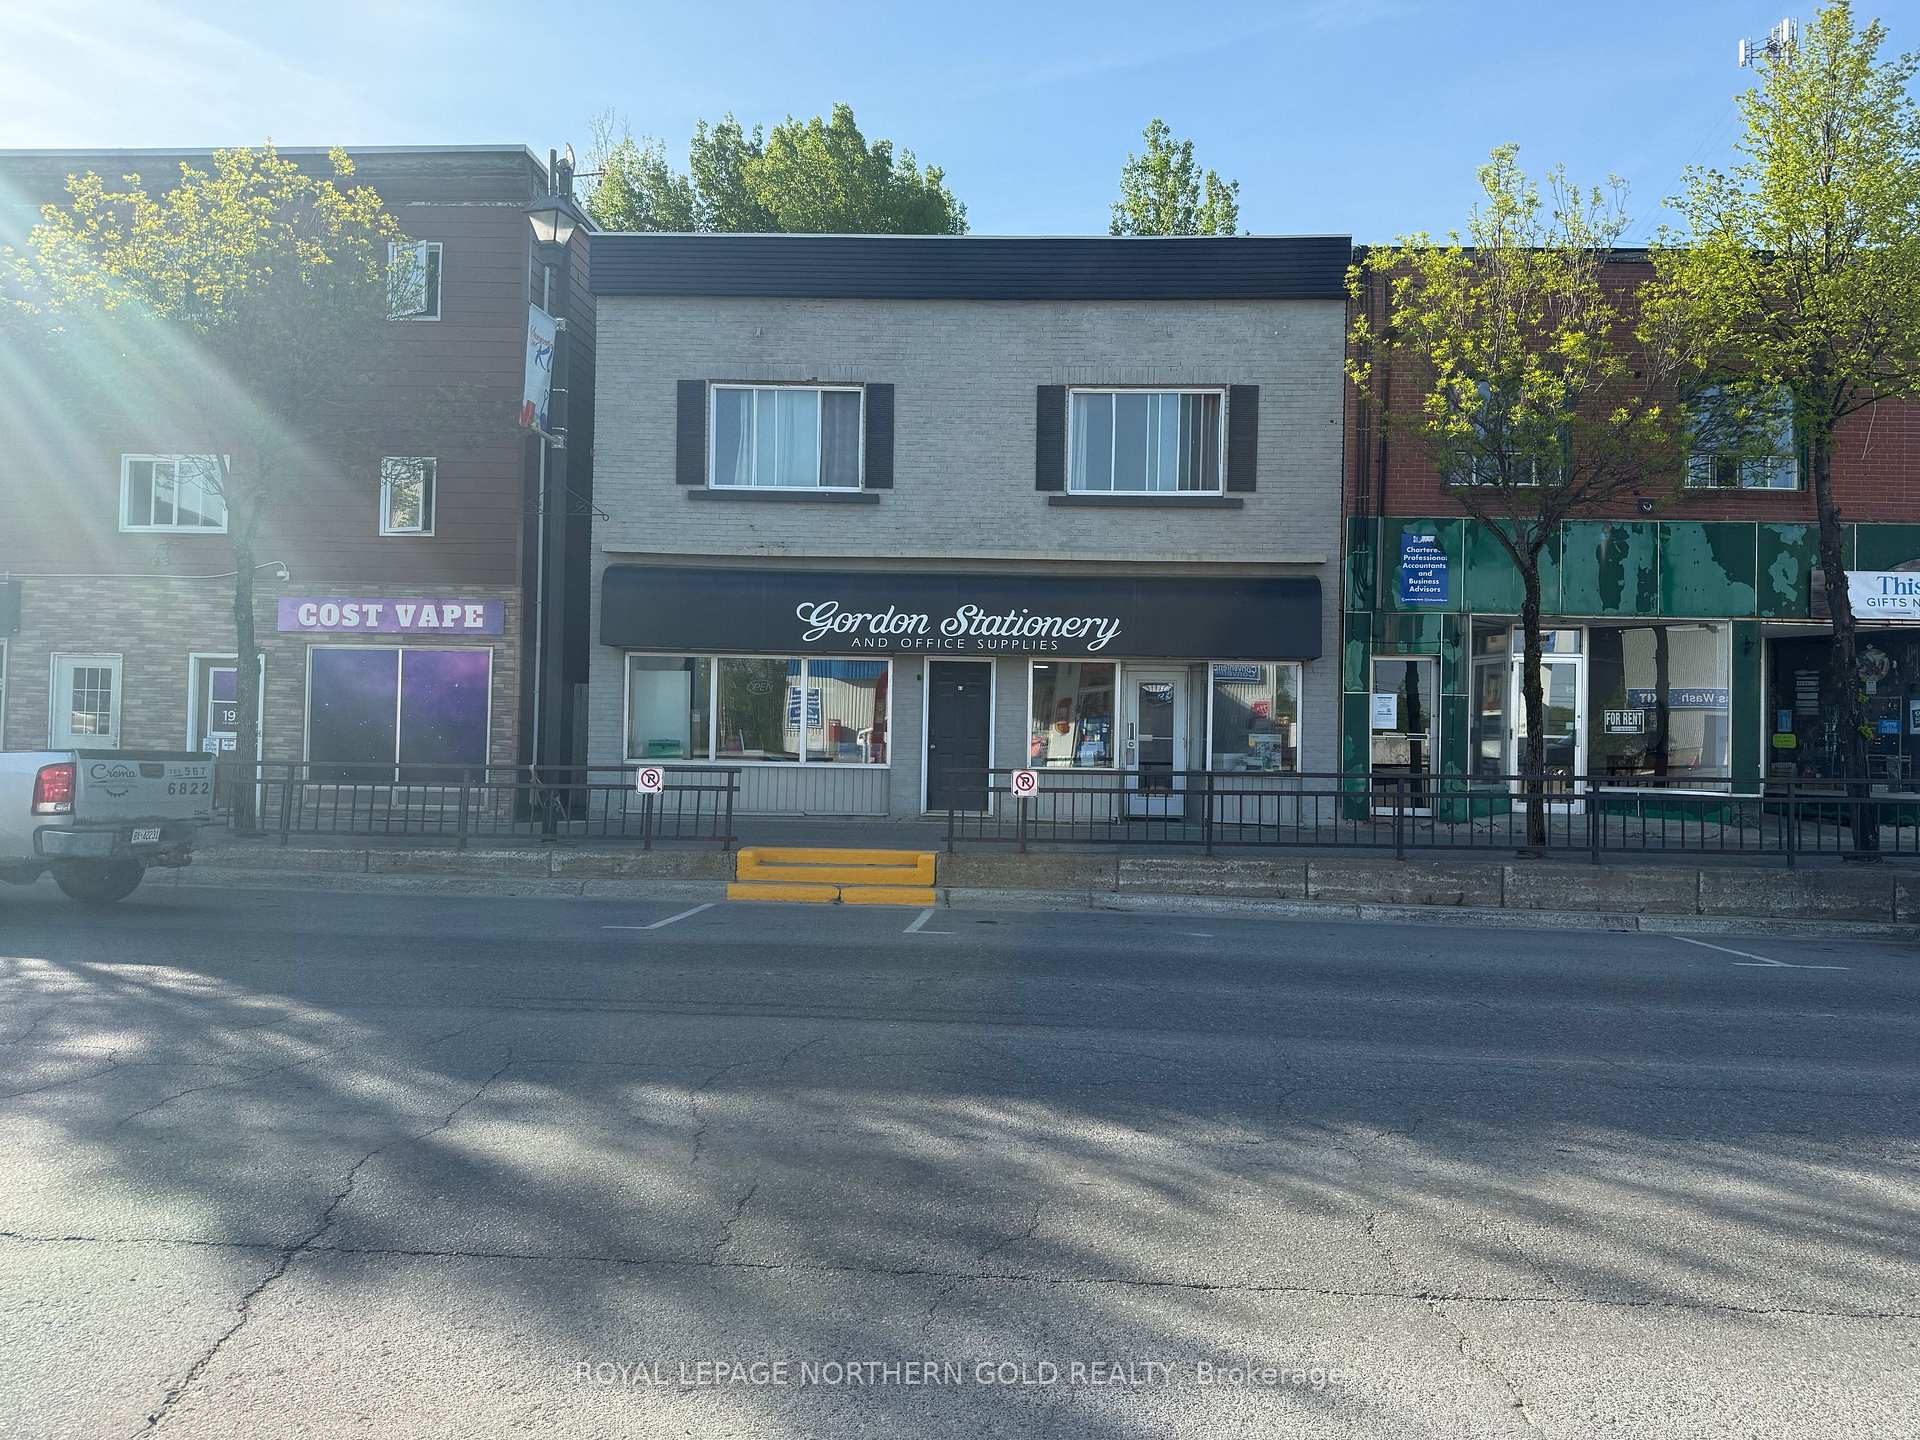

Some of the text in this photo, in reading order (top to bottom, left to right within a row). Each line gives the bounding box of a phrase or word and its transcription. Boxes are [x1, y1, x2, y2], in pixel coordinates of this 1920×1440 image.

[1418, 569, 1433, 577] and
[1408, 577, 1440, 585] Business
[1408, 585, 1441, 593] Advisors
[1866, 597, 1908, 607] GIFTS
[298, 603, 484, 628] COST VAPE
[796, 601, 1122, 651] Gordon Stationery
[851, 637, 1058, 650] AND OFFICE SUPPLIES
[1606, 713, 1642, 725] FOR RENT
[184, 766, 207, 776] 567
[167, 782, 209, 796] 6822
